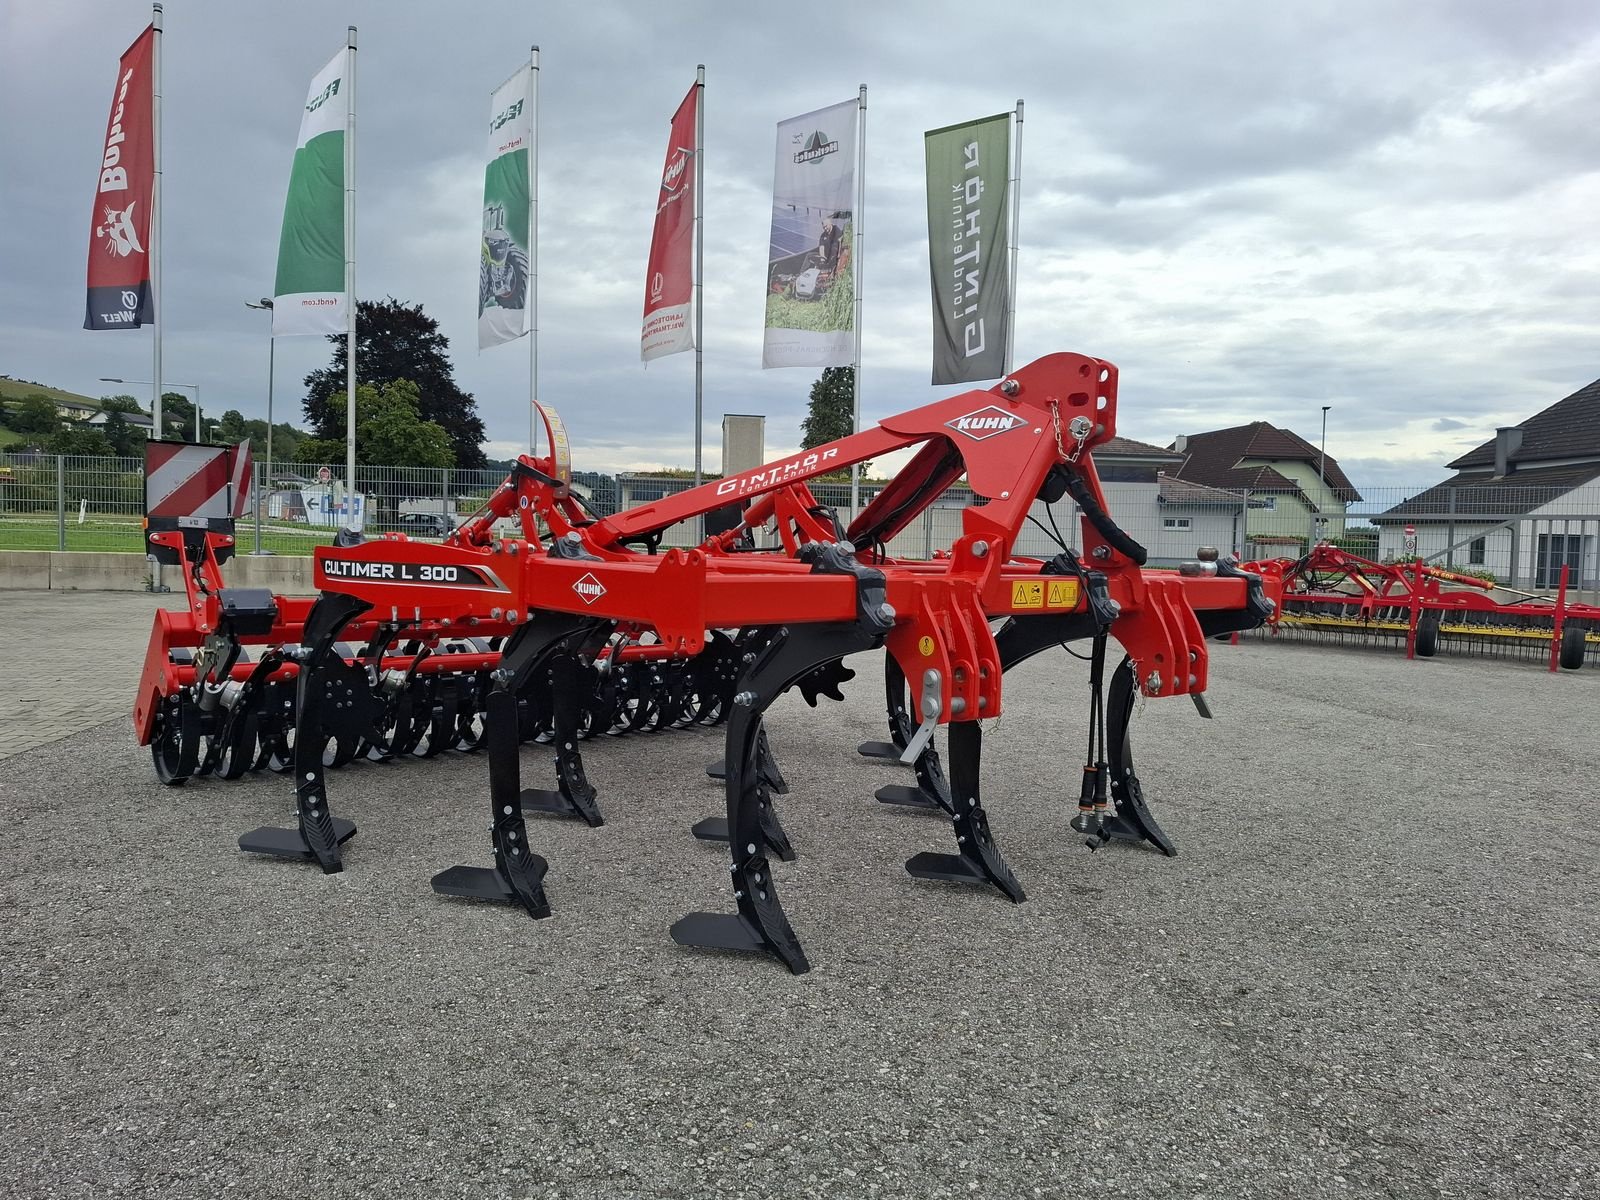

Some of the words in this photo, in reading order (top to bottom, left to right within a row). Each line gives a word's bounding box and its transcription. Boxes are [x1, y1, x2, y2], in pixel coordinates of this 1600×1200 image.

[957, 416, 1014, 430] KUHN
[555, 434, 565, 443] 5
[559, 451, 567, 461] 3
[559, 470, 566, 479] 1
[324, 560, 395, 578] CULTIMER
[401, 565, 413, 579] L
[419, 566, 458, 582] 300
[577, 582, 601, 596] KUHN
